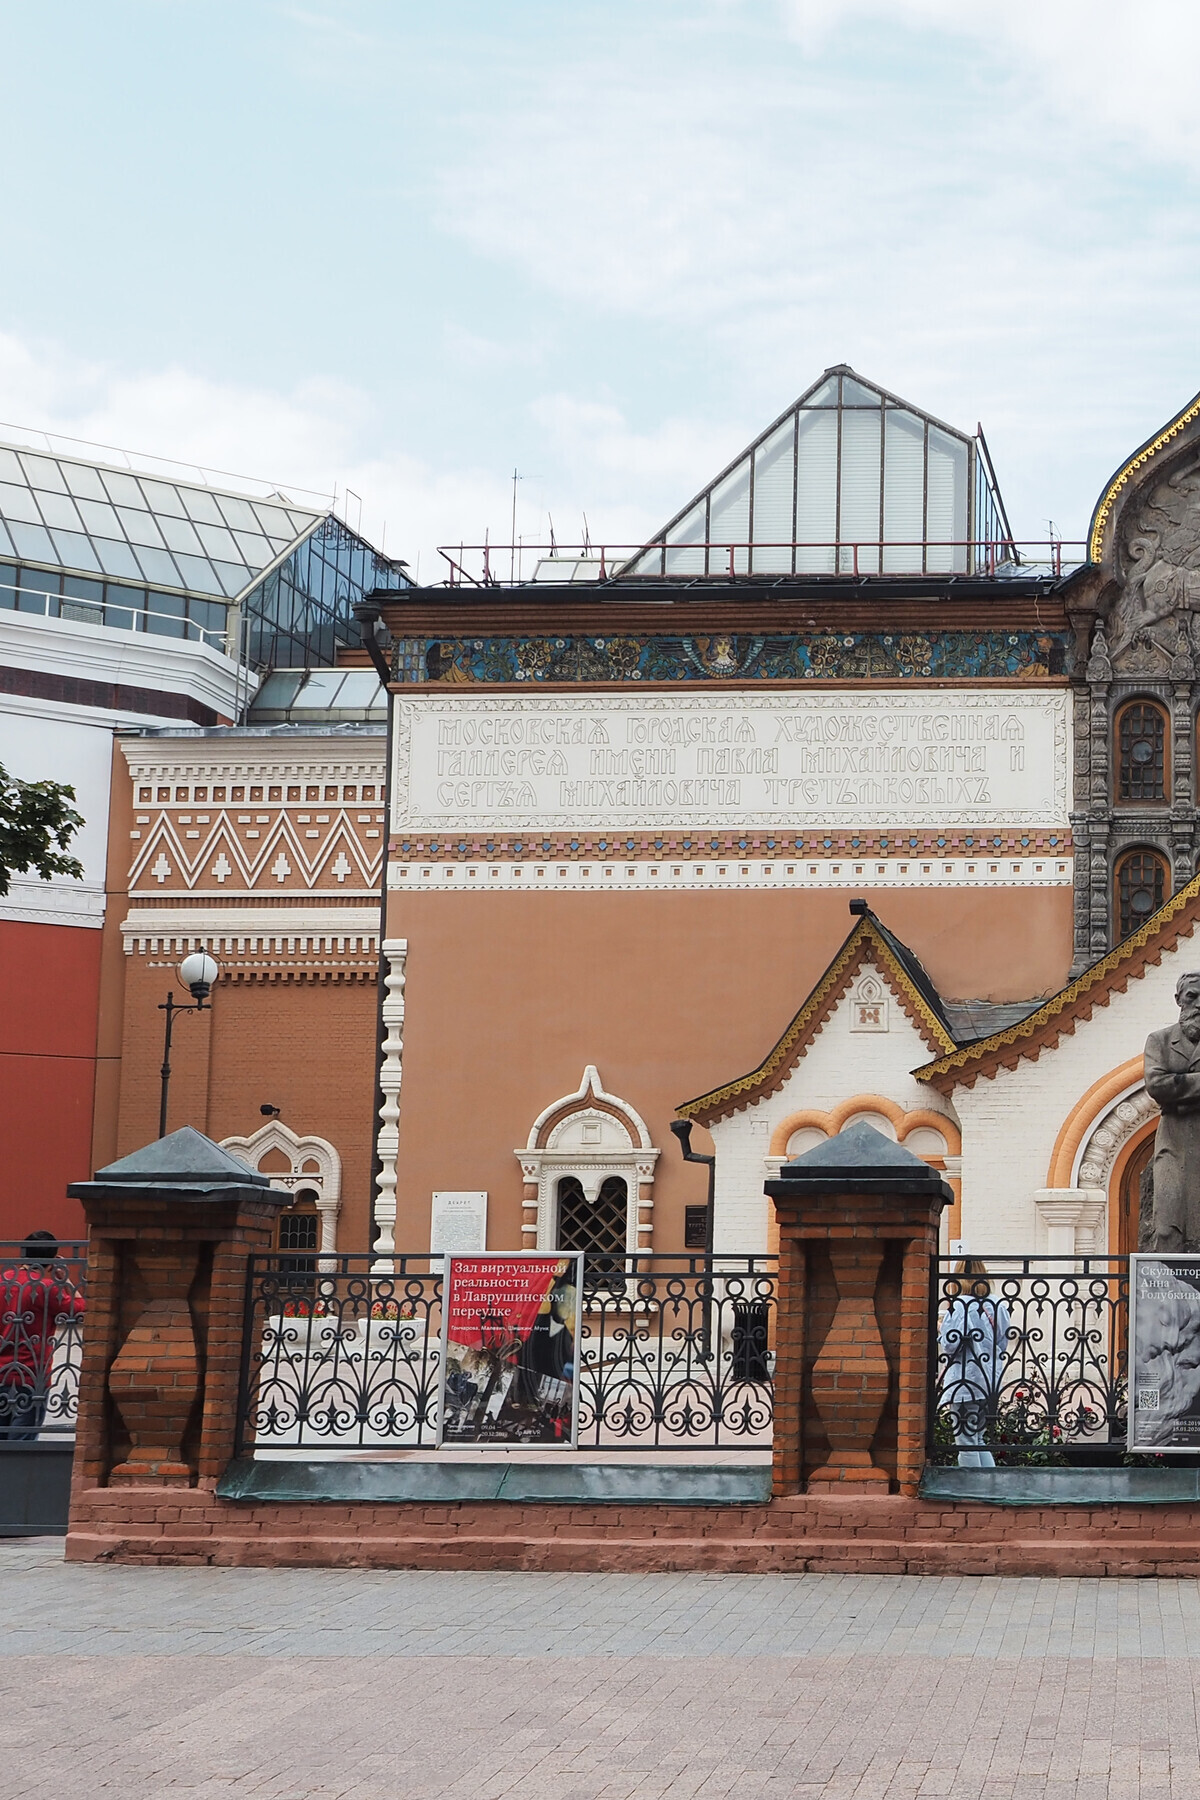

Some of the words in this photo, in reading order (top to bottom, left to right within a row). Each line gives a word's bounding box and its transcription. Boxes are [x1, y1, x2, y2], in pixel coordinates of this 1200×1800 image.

[589, 748, 677, 775] ИМЕНИ
[696, 747, 779, 774] ПАВЛА
[1009, 745, 1025, 772] И
[454, 1262, 478, 1274] Зал
[480, 1261, 568, 1278] виртуальной
[453, 1278, 529, 1291] реальности
[1140, 1278, 1170, 1288] Анна
[453, 1293, 461, 1302] в
[462, 1291, 565, 1305] Лаврушинском
[452, 1306, 512, 1320] переулке
